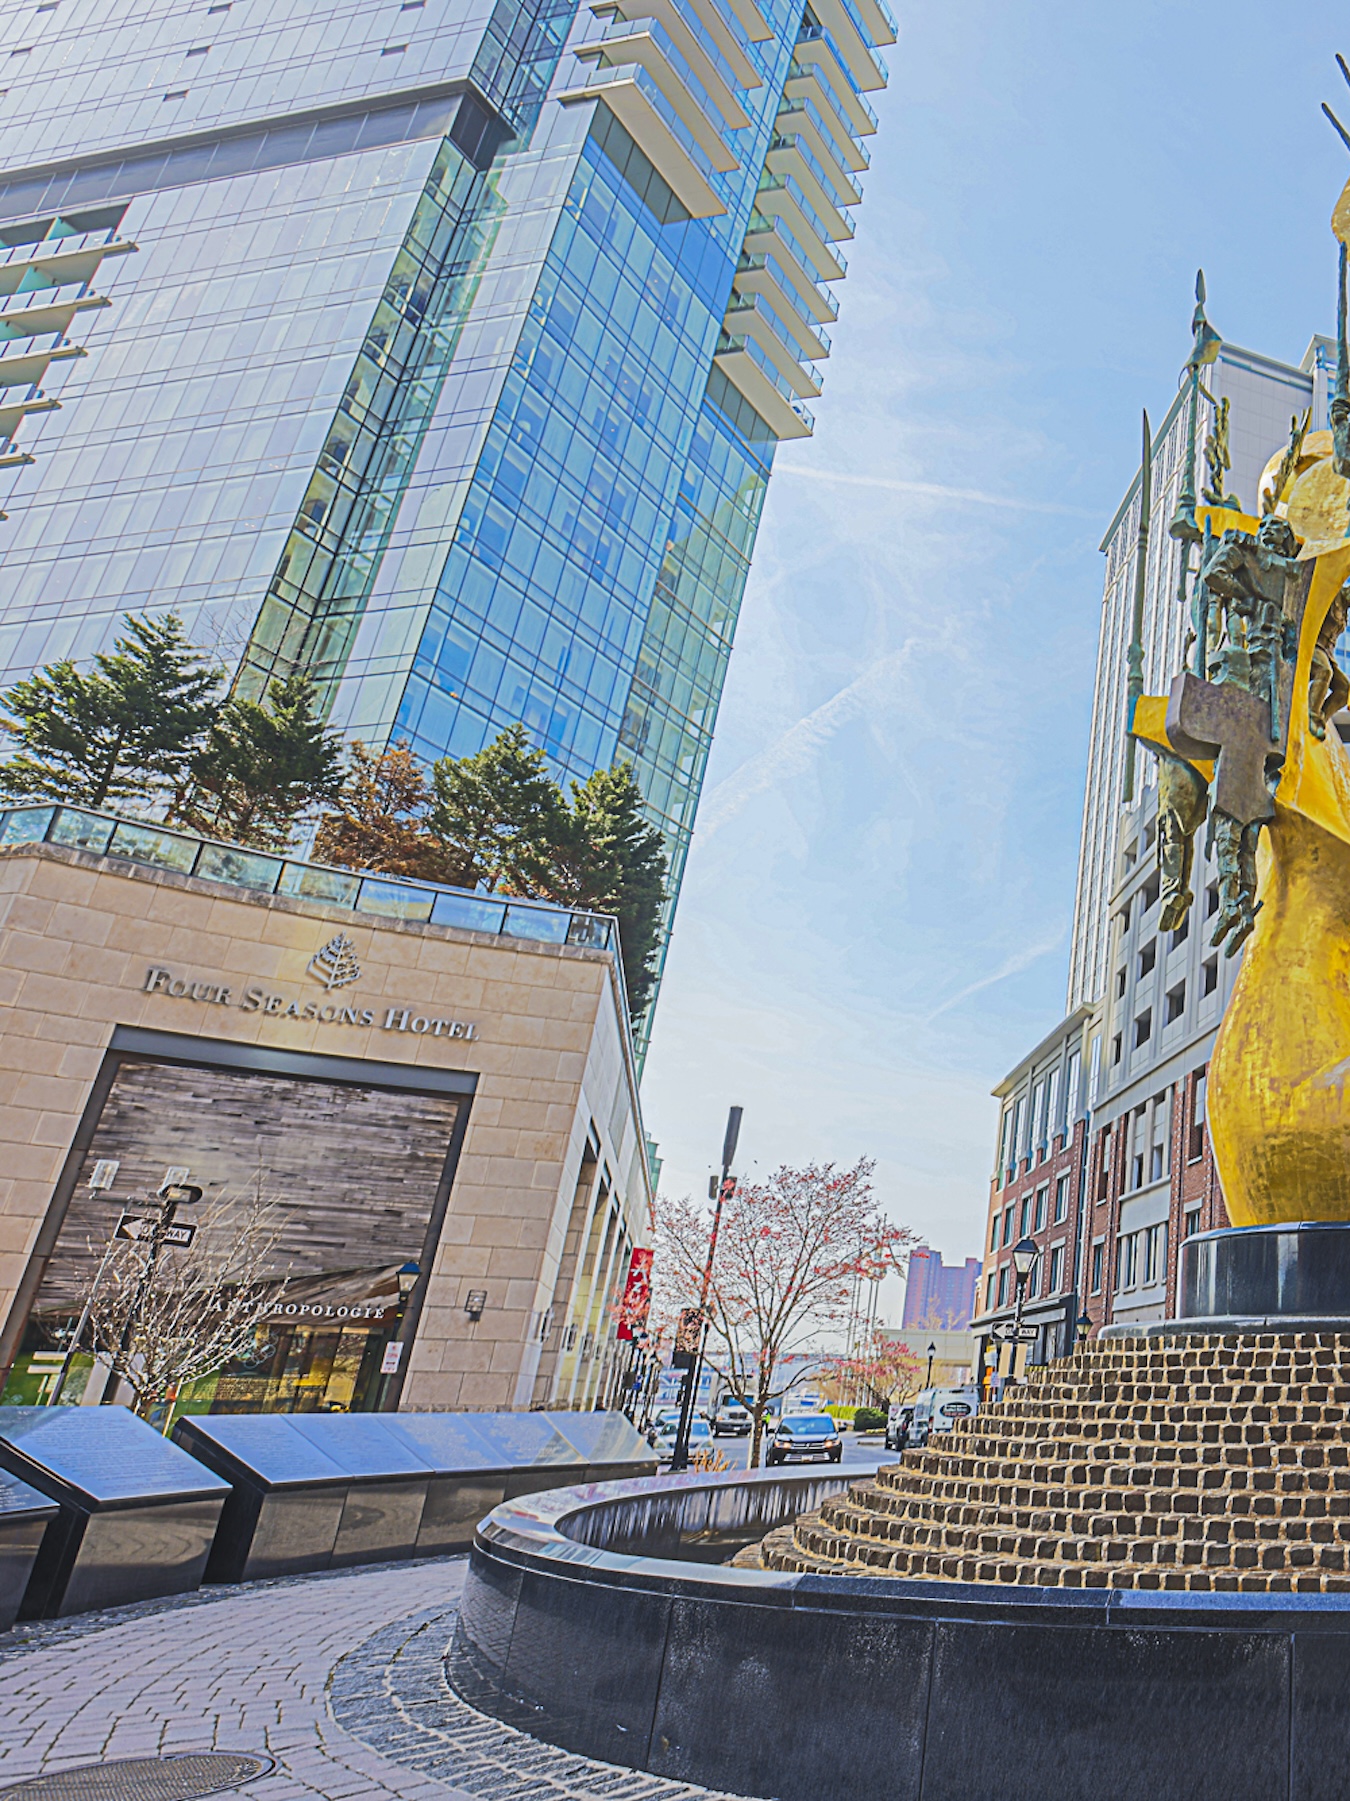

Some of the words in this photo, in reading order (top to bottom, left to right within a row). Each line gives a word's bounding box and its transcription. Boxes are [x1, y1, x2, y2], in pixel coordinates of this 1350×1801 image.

[143, 967, 232, 1005] FOUR
[240, 986, 375, 1027] SEASONS
[382, 1007, 480, 1042] HOTEL
